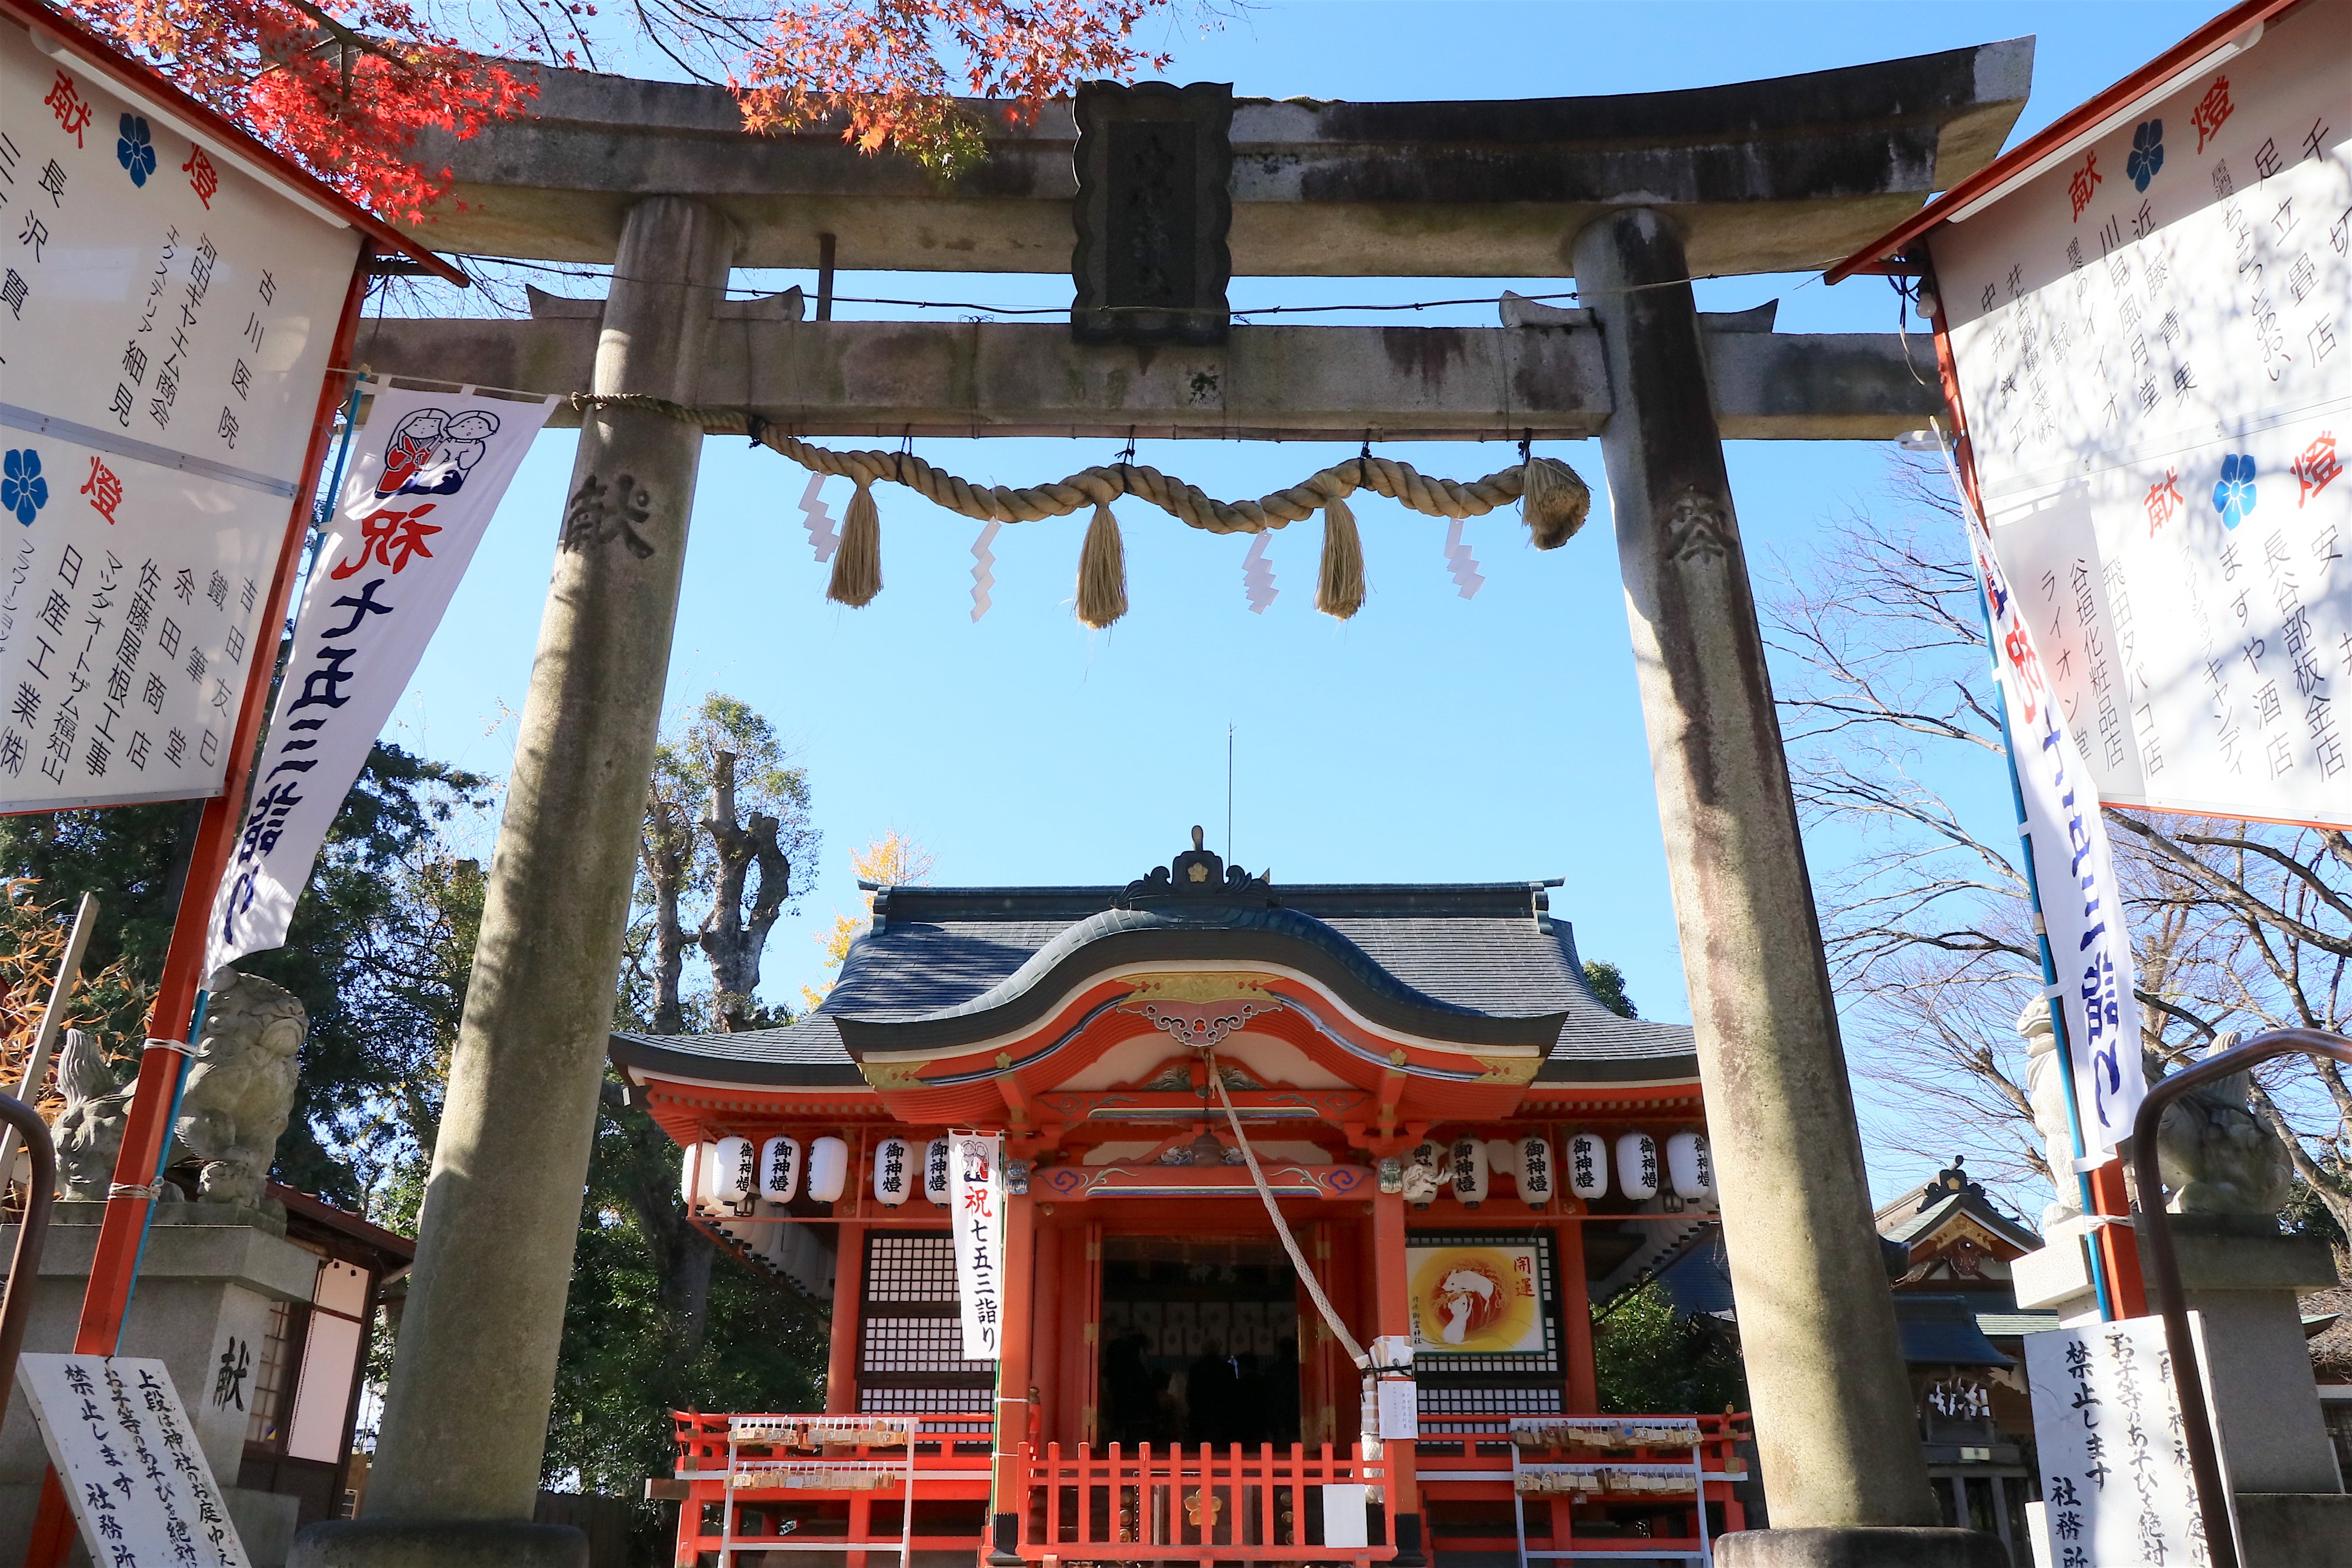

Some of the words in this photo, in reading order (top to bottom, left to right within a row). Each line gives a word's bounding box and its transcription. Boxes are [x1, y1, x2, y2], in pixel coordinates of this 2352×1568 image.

[44, 70, 92, 149] 献
[2067, 149, 2102, 224] 献
[2191, 75, 2235, 155] 燈
[0, 158, 67, 365] 長沢貫
[109, 225, 179, 427] エクステリア細見
[2100, 214, 2162, 419] 川見風月堂
[2131, 199, 2198, 407] 近藤青果
[2255, 137, 2336, 368] 足立畳店
[218, 269, 276, 449] 古川医院
[1982, 282, 2027, 454] 中井鉄工
[81, 456, 122, 525] 燈
[2142, 465, 2184, 539] 献
[2290, 430, 2343, 509] 燈
[41, 550, 123, 785] マツダオートザム福知山
[86, 558, 161, 777] 佐藤屋根工事
[126, 569, 195, 771] 余田商店
[2041, 570, 2091, 760] ライオン堂
[2070, 558, 2124, 772] 谷垣化粧品店
[2103, 556, 2164, 780] 飛田タバコ店
[2219, 541, 2294, 780] ますや酒店
[2263, 528, 2346, 783] 長谷部板金店
[770, 1141, 792, 1191] 御神燈
[883, 1142, 904, 1193] 御神燈
[929, 1141, 948, 1191] 御神燈
[1454, 1142, 1476, 1192] 御神燈
[1525, 1141, 1547, 1191] 御神燈
[1574, 1138, 1594, 1188] 御神燈
[964, 1186, 997, 1352] 祝七五三詣り
[1514, 1256, 1535, 1296] 開運
[65, 1364, 134, 1501] 禁止します
[2066, 1341, 2112, 1492] 禁止します
[86, 1483, 136, 1568] 社務所
[2050, 1476, 2088, 1568] 社務所
